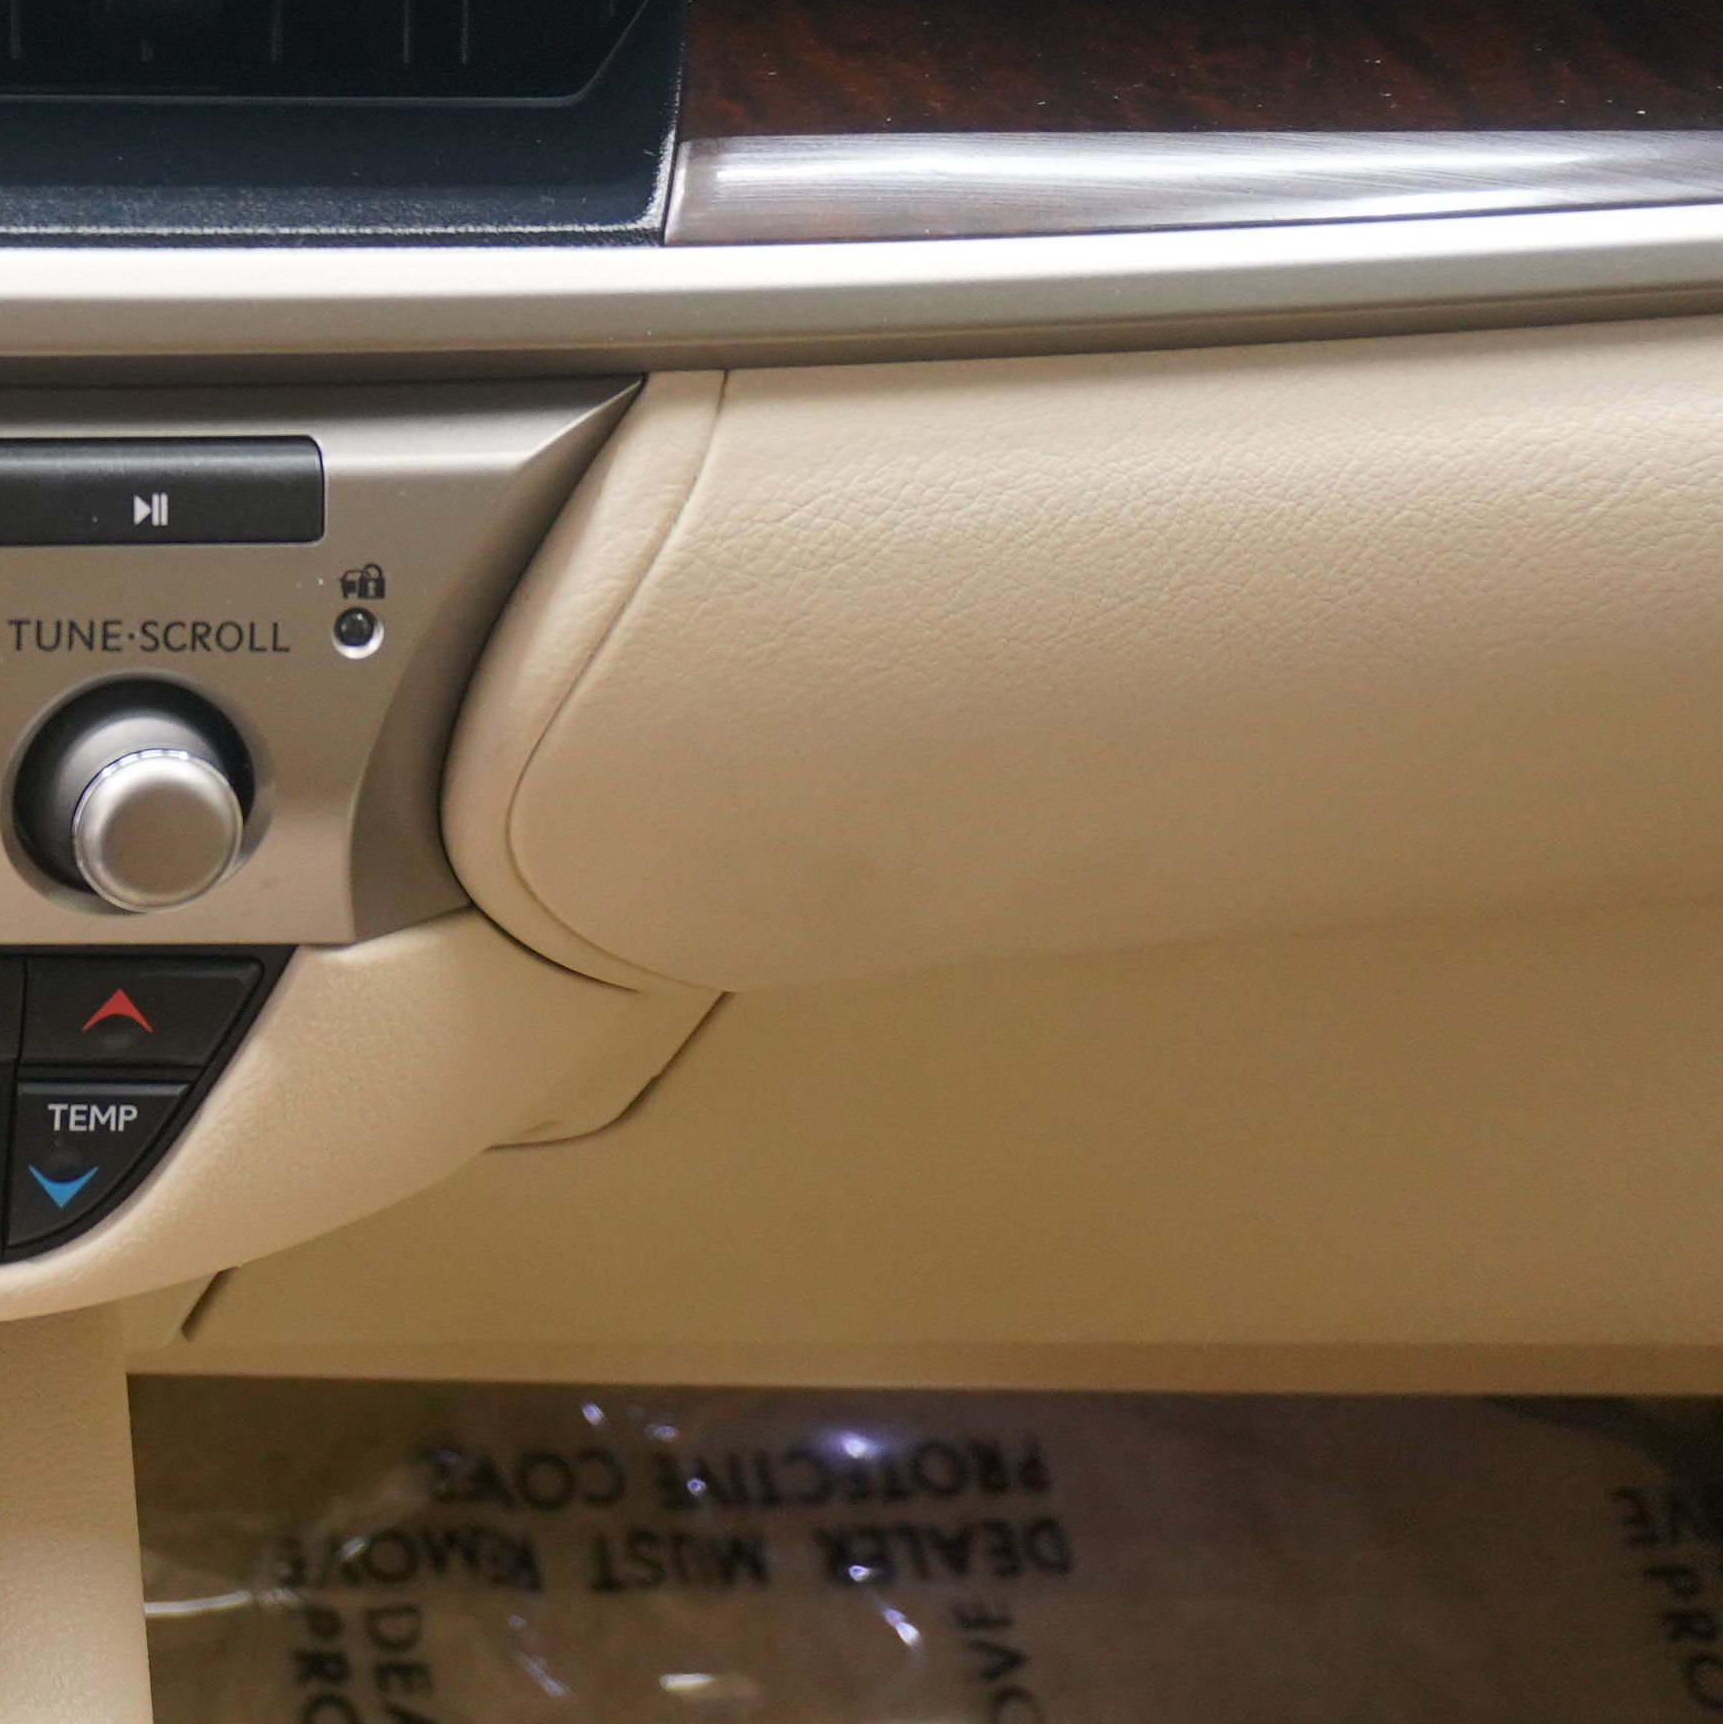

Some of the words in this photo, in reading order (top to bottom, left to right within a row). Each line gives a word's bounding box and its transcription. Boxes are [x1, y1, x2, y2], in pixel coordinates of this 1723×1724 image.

[48, 1103, 138, 1134] TEMP
[591, 1527, 768, 1595] MUST
[817, 1519, 1072, 1592] DEALER
